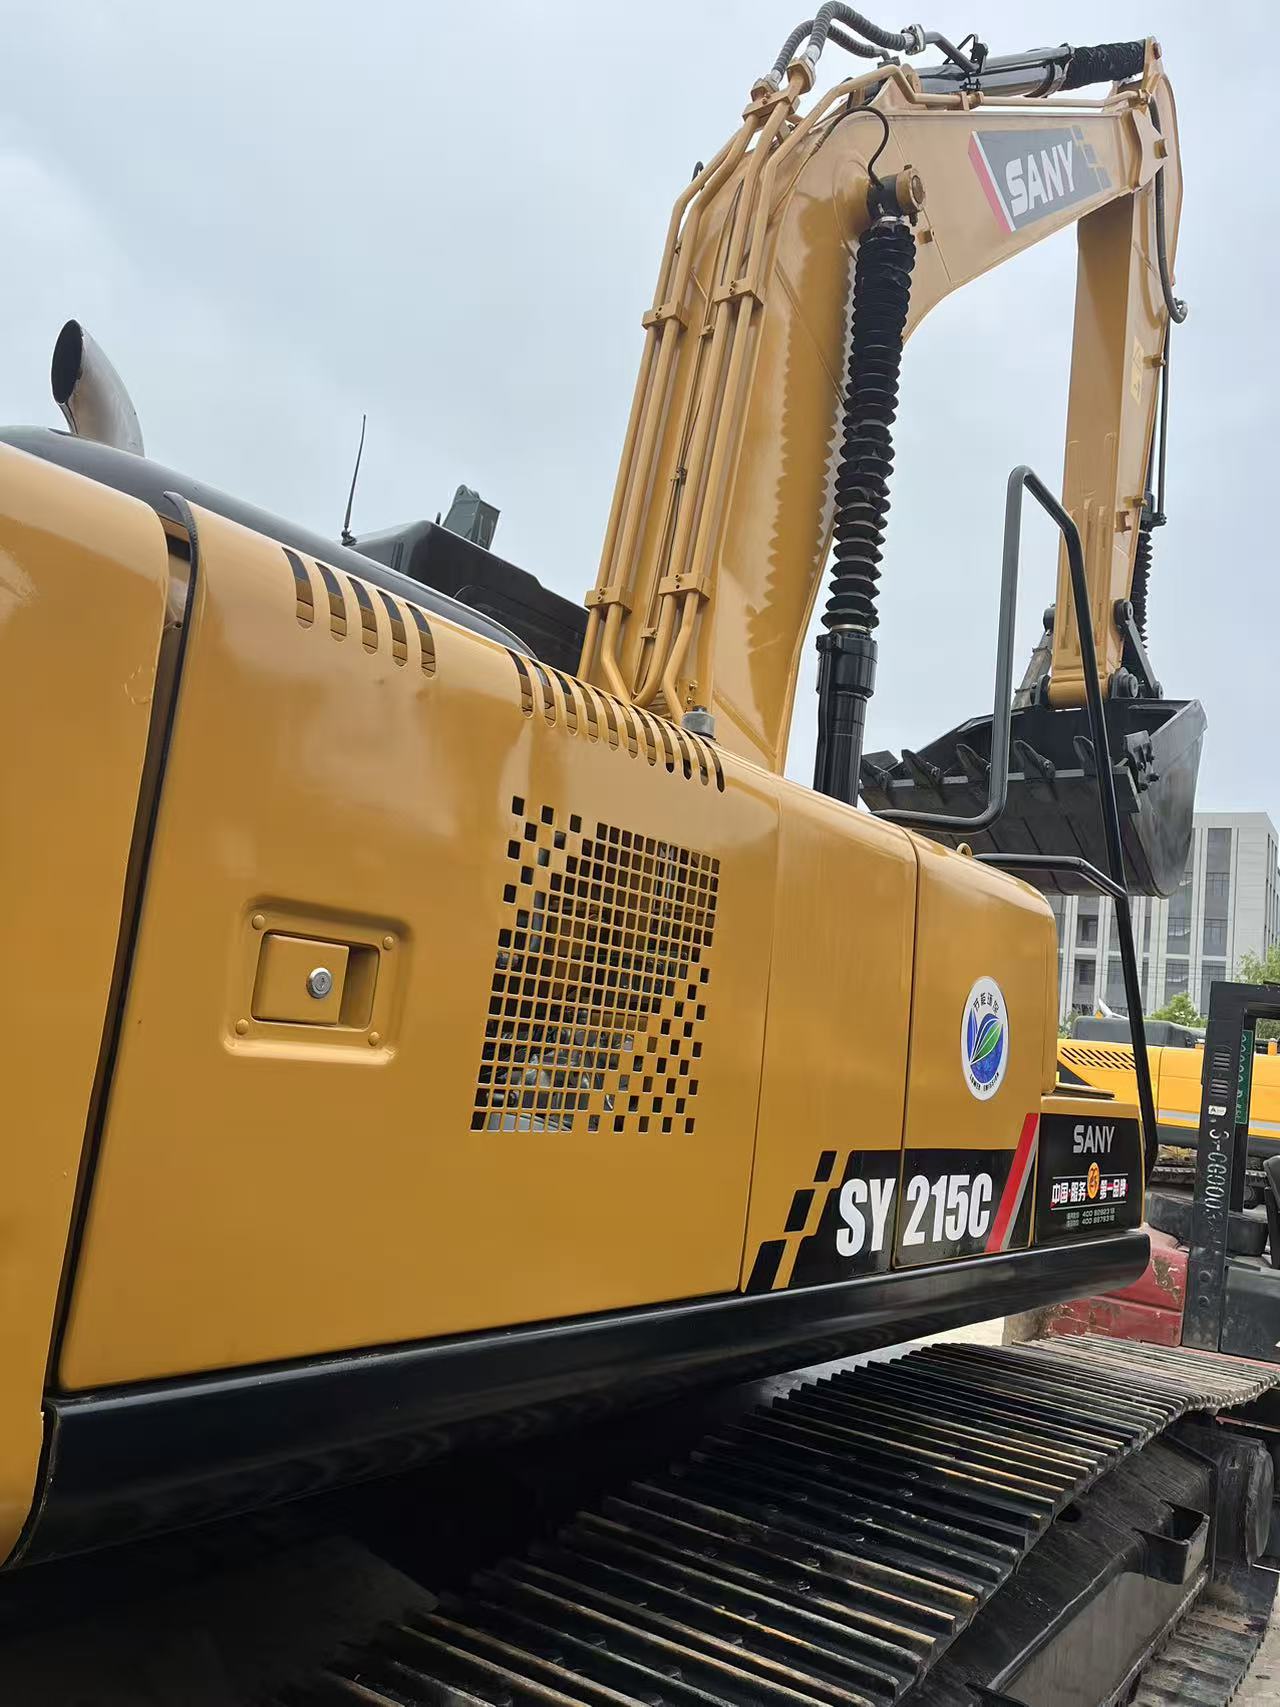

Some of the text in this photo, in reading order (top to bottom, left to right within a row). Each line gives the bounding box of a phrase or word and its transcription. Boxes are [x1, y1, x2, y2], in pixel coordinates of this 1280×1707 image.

[1005, 140, 1075, 217] SANY
[1073, 1124, 1115, 1153] SANY
[836, 1172, 993, 1257] SY 215C
